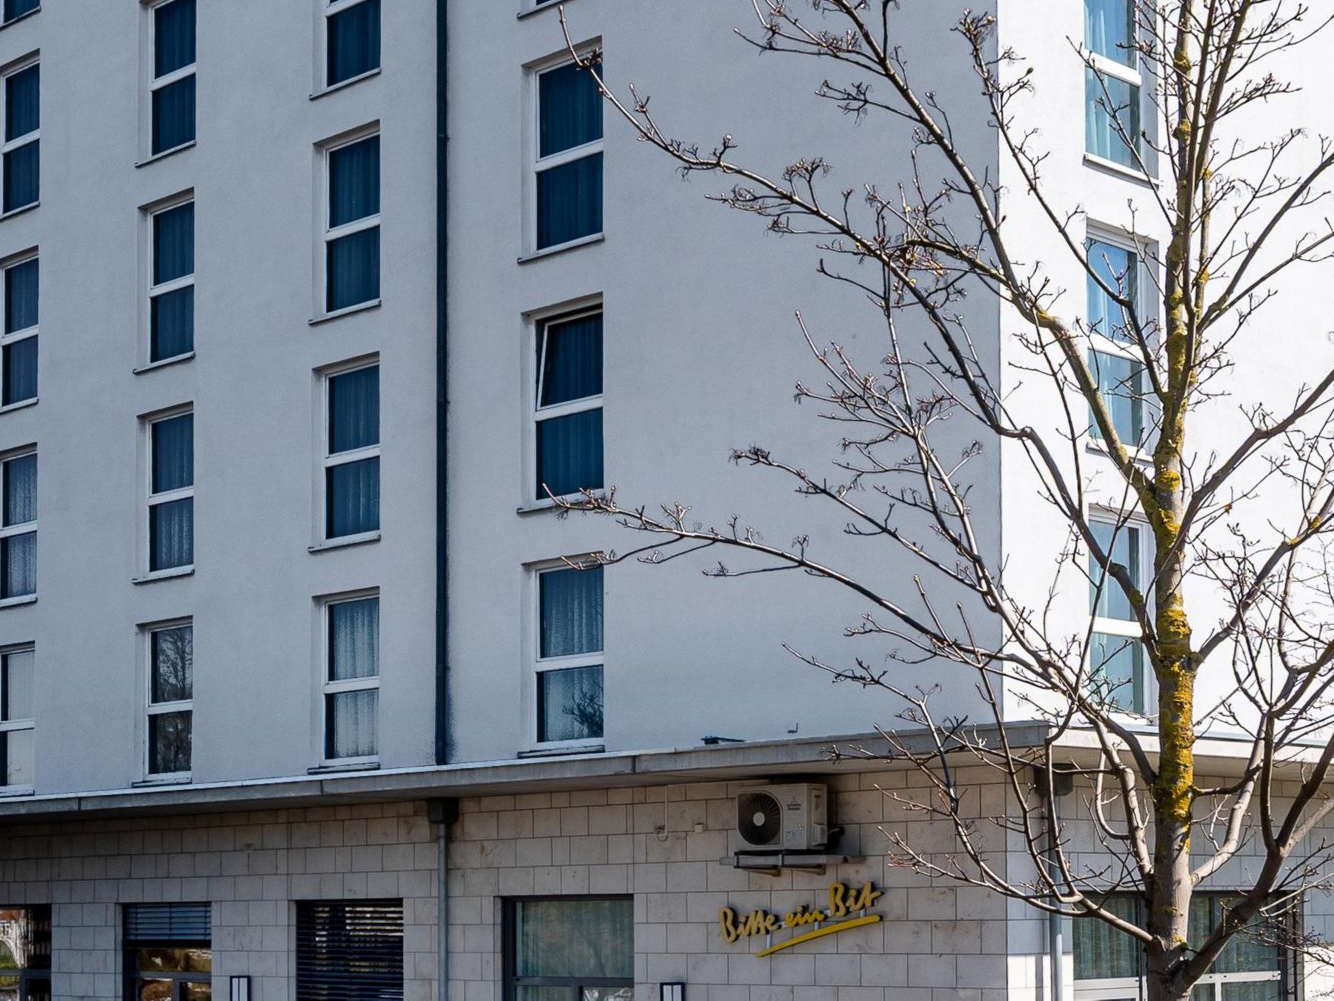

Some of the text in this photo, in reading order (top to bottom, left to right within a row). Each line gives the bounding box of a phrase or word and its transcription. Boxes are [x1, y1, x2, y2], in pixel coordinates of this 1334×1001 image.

[719, 880, 883, 943] Bitte ein Bit
